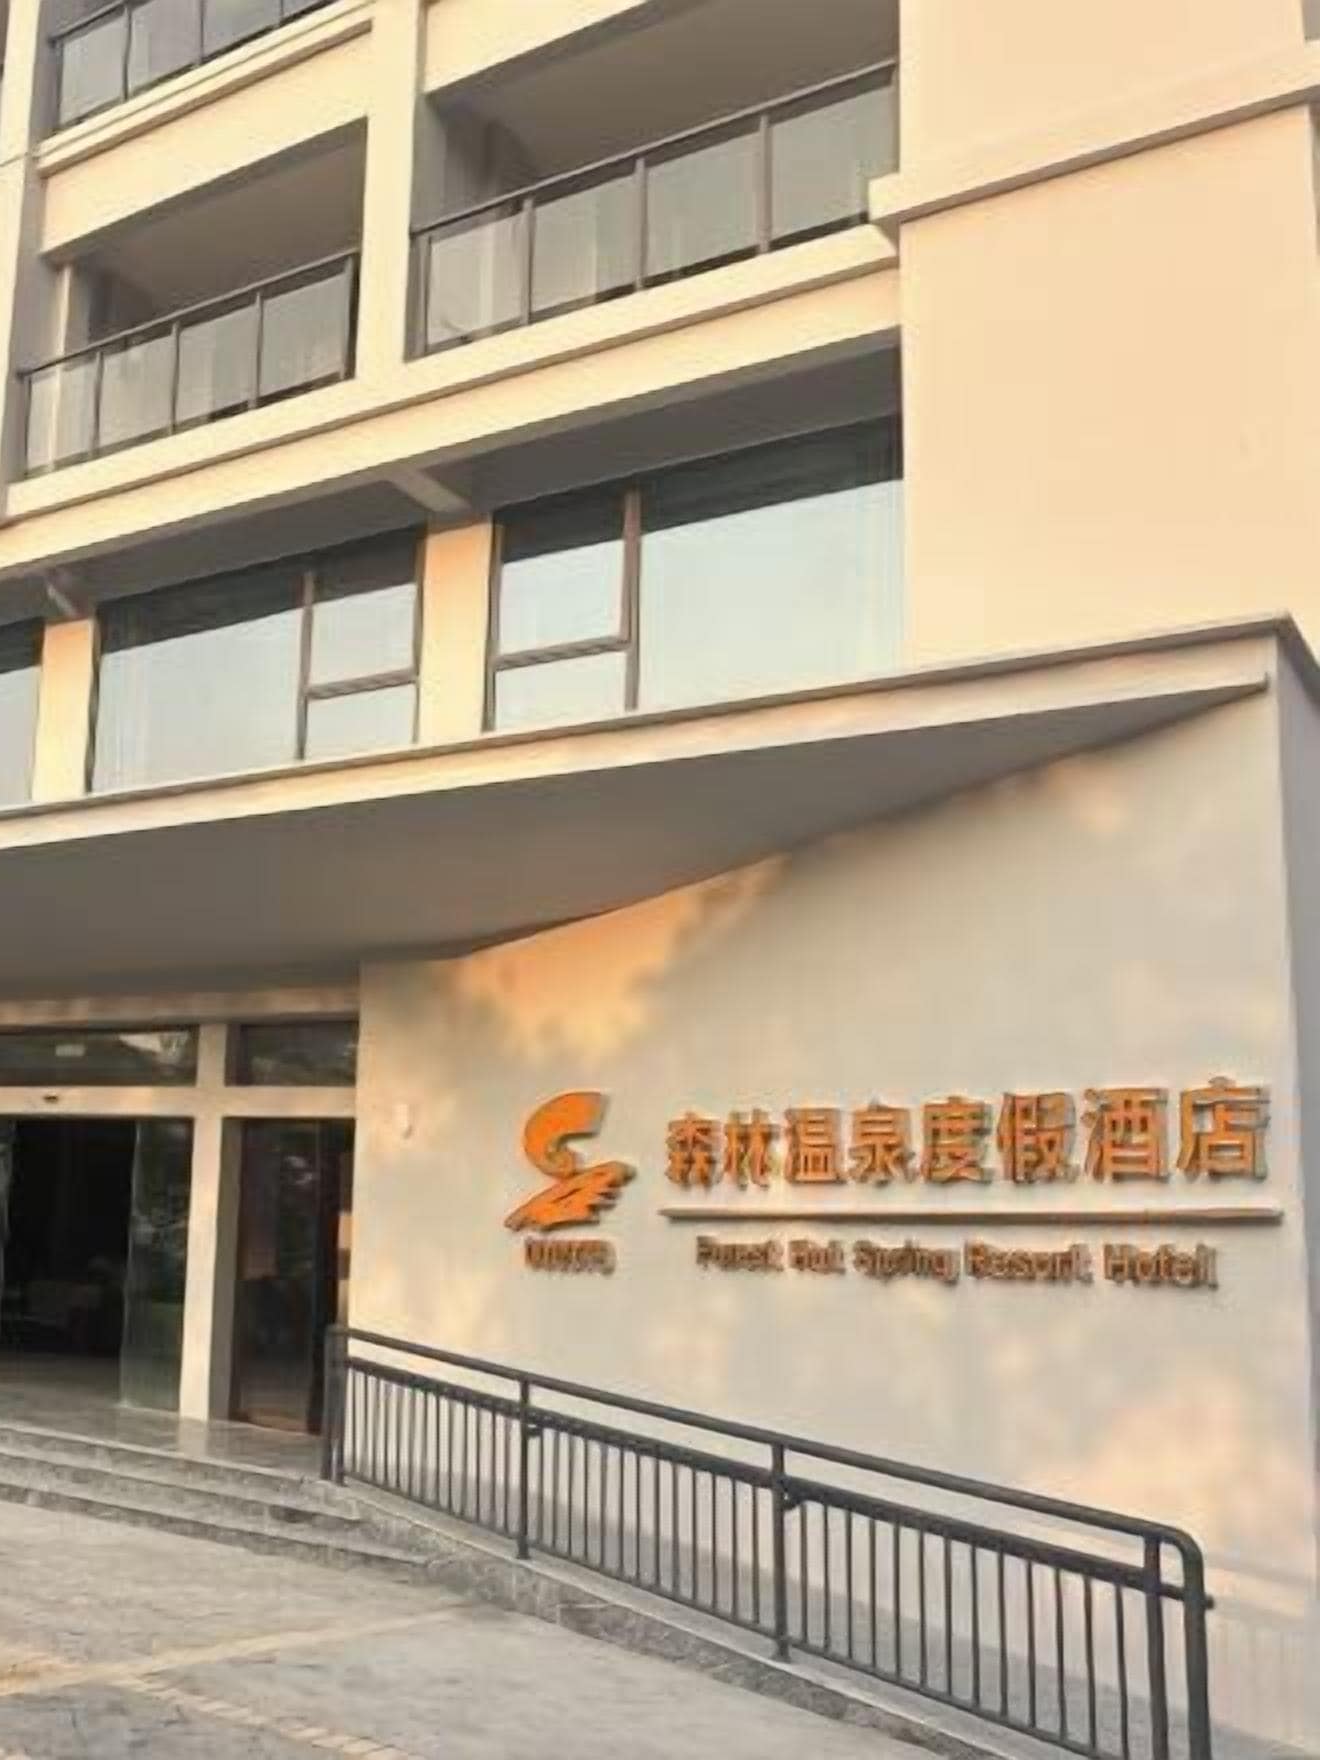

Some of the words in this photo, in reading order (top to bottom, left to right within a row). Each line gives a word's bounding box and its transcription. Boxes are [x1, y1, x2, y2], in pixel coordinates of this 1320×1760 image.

[666, 1075, 1270, 1190] 森林温泉度假酒店
[964, 1240, 1093, 1286] Resort
[1103, 1243, 1219, 1290] Hotel
